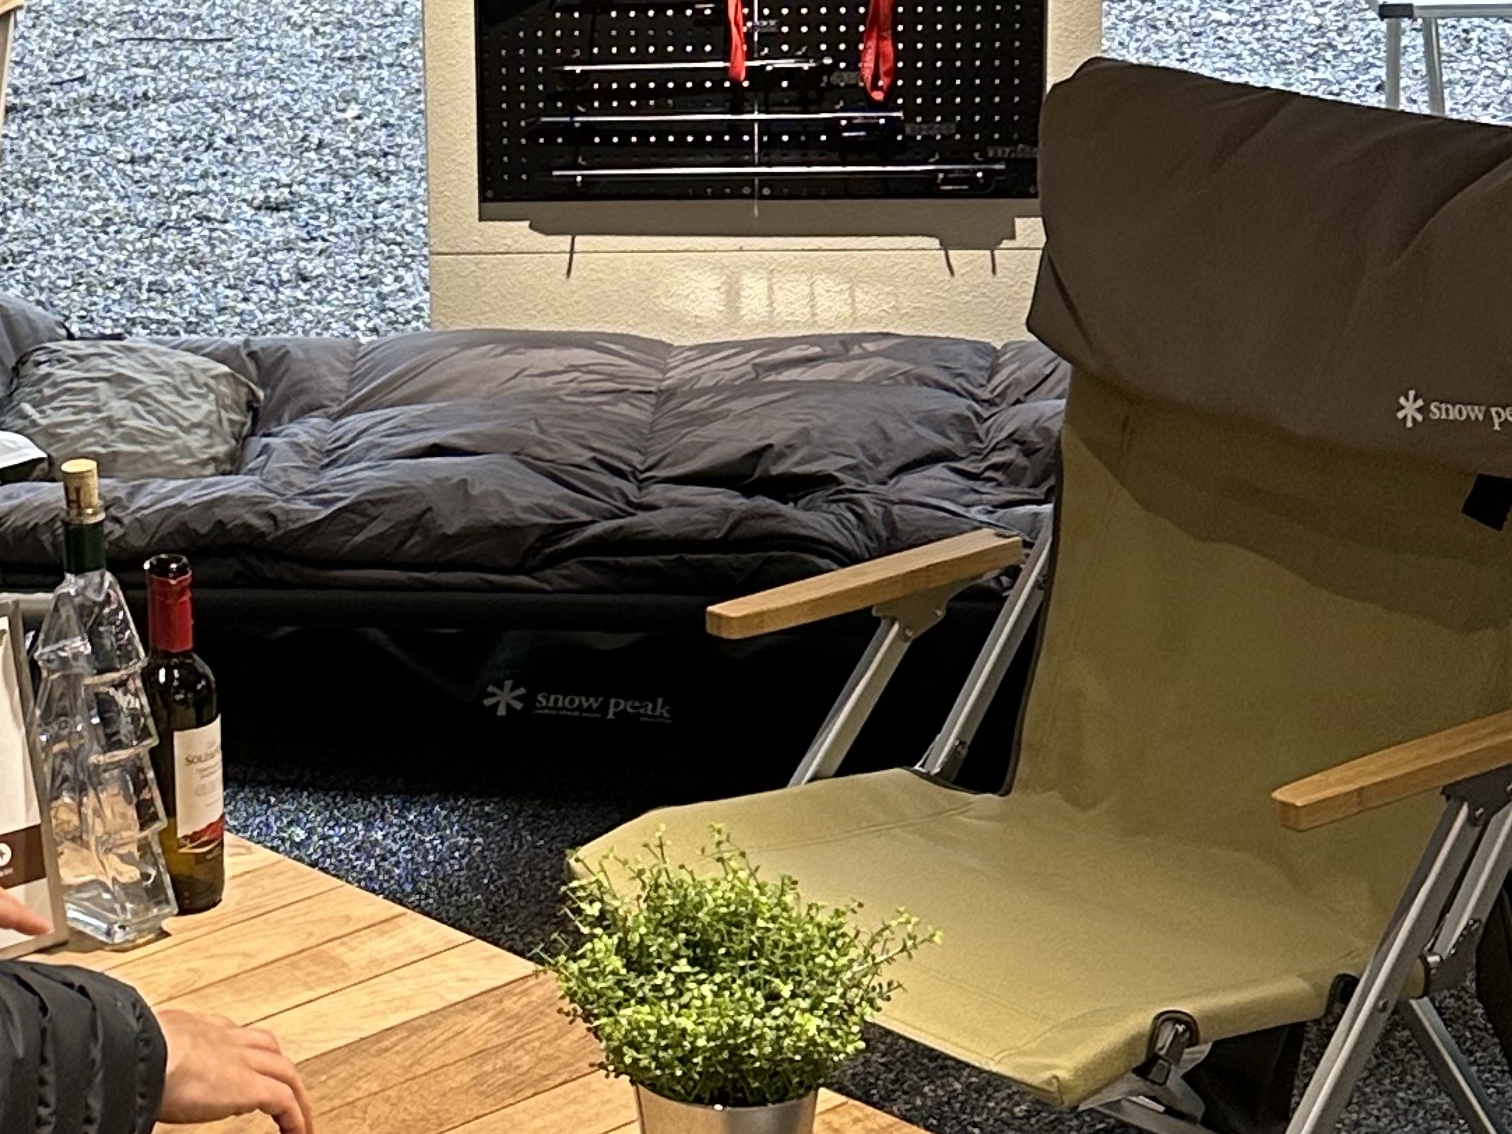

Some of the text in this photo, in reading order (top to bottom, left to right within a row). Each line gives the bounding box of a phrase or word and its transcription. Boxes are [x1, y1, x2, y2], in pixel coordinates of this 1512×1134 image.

[1429, 401, 1486, 421] snow
[536, 691, 604, 710] snow
[606, 697, 672, 719] peak
